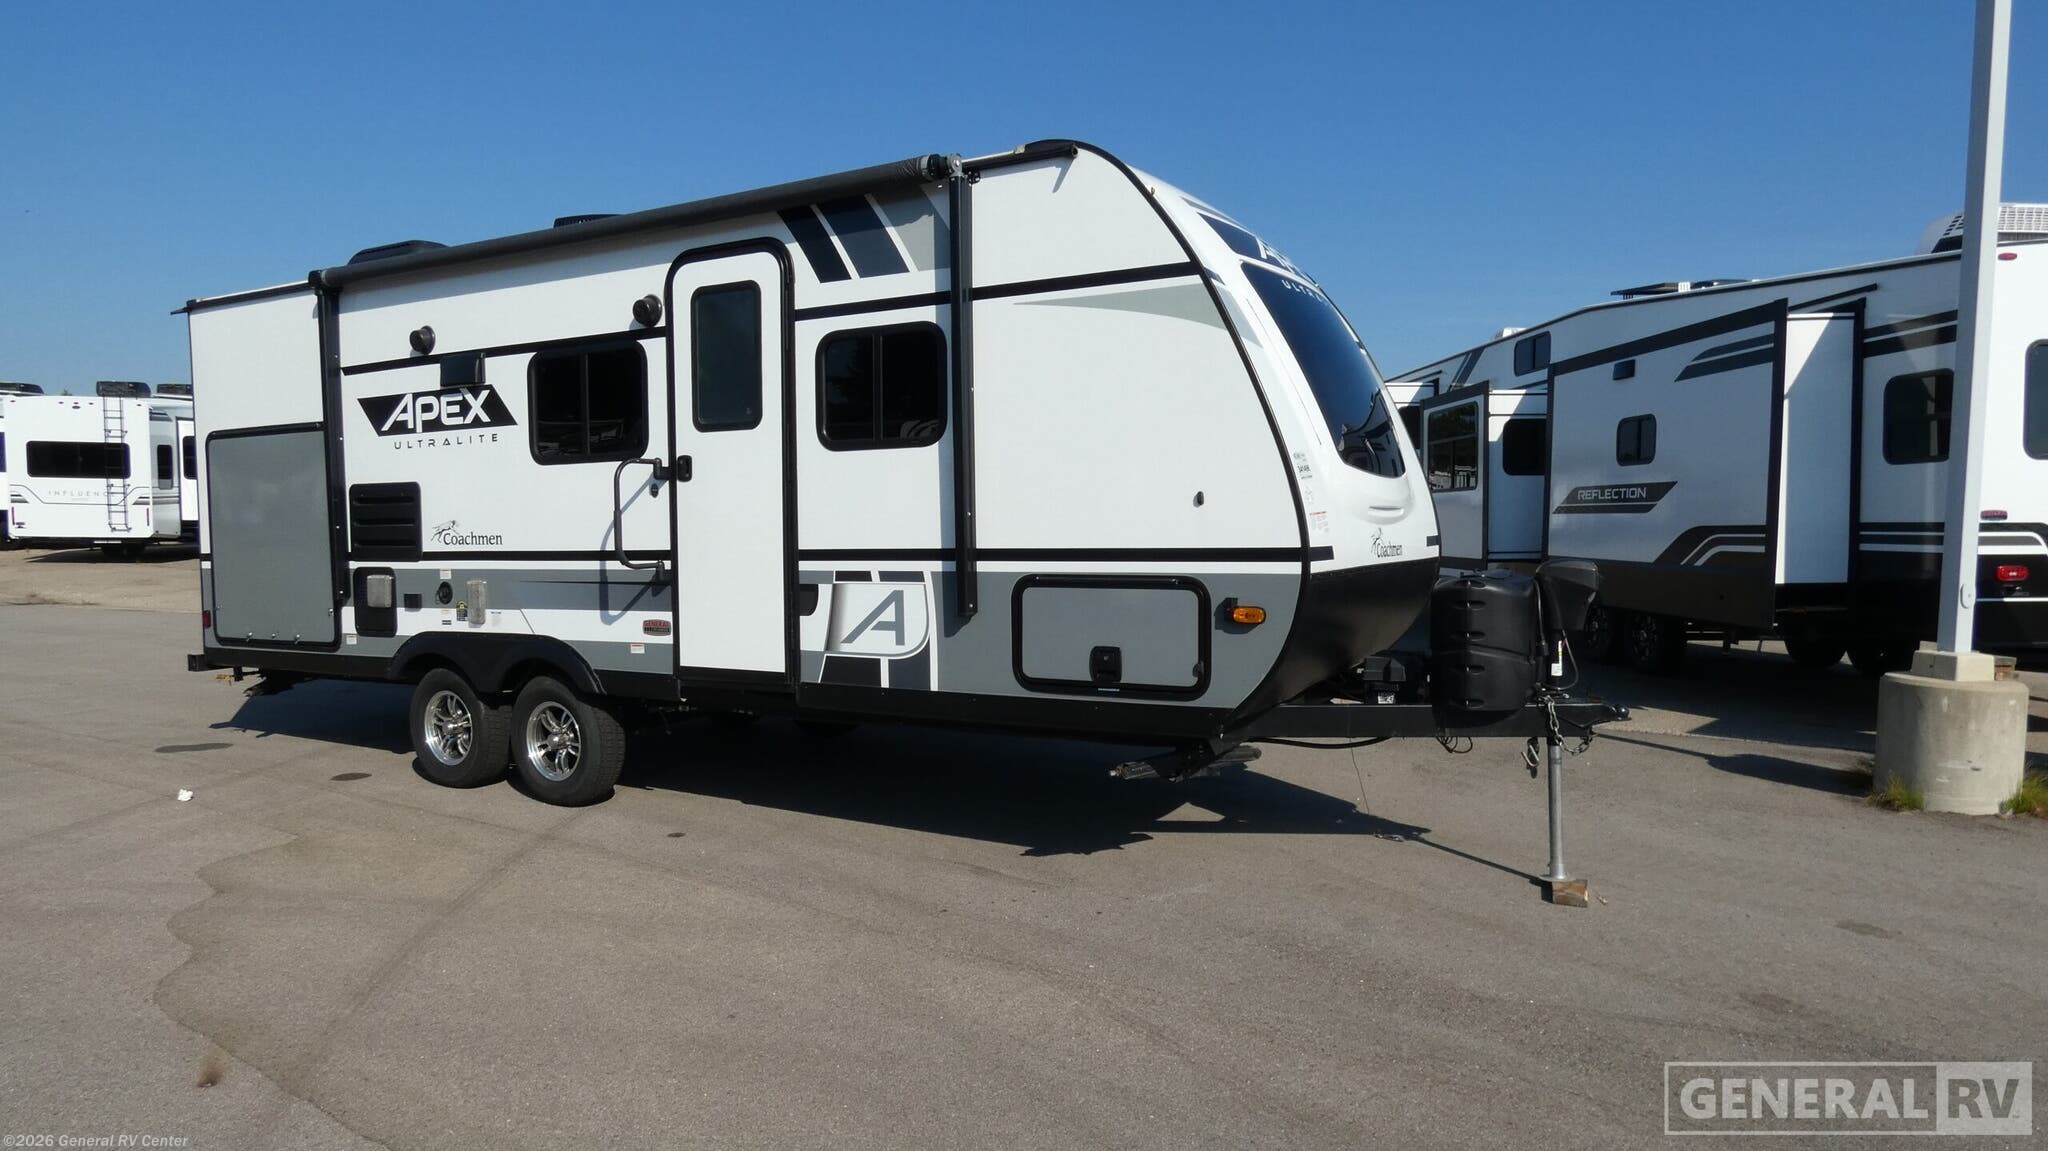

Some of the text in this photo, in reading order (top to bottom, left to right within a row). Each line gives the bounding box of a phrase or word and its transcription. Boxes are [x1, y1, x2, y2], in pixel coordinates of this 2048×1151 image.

[381, 388, 491, 433] APEX
[394, 433, 499, 449] ULTRALITE
[1577, 487, 1647, 500] REFLECTION
[443, 531, 503, 545] Coachmen
[1377, 541, 1403, 558] Coachmen
[840, 590, 905, 646] A
